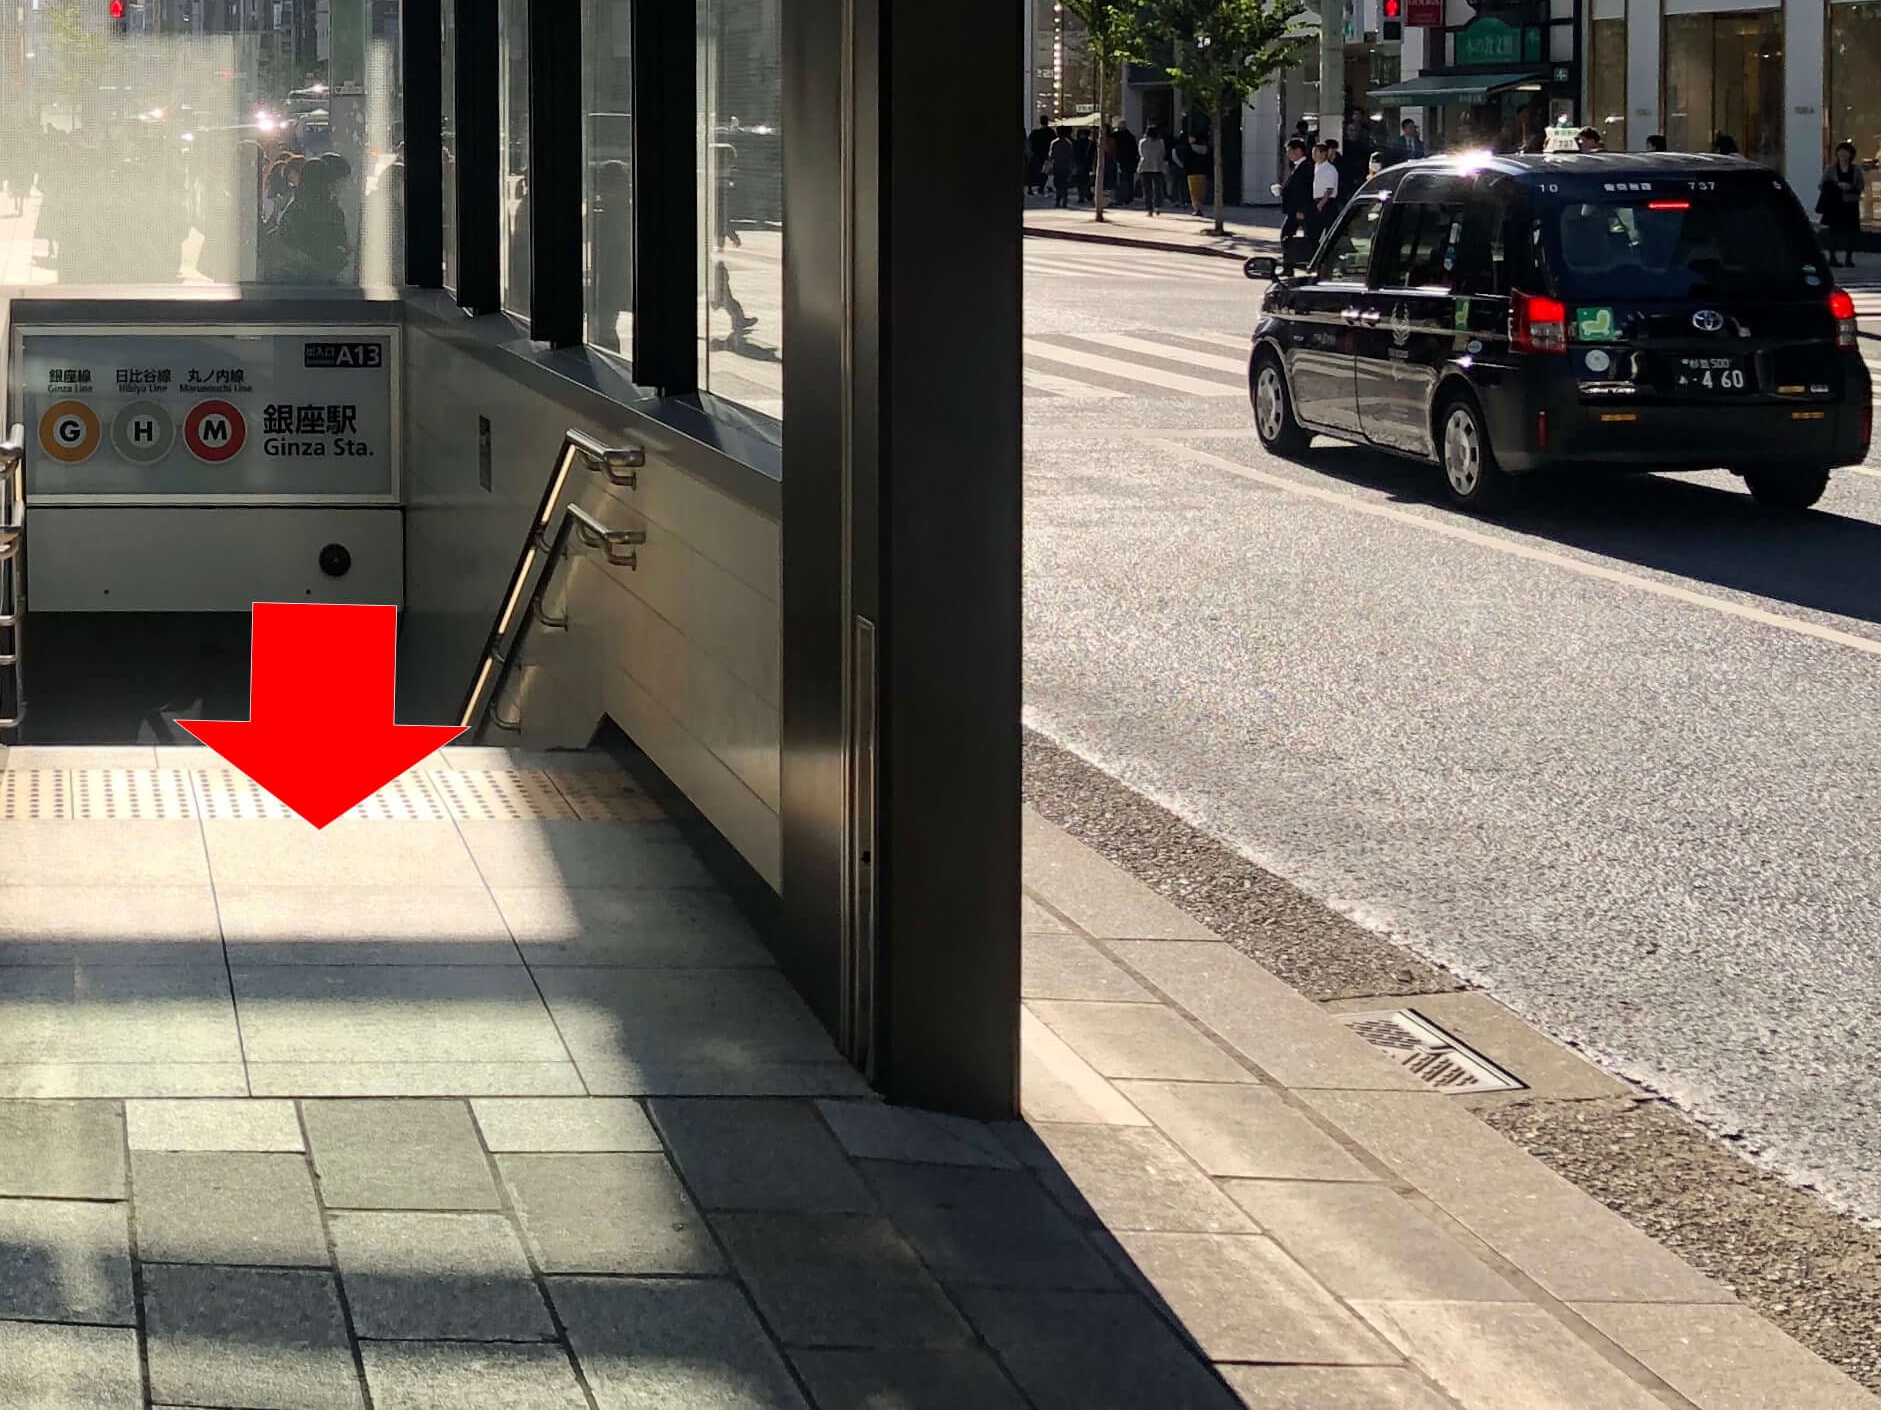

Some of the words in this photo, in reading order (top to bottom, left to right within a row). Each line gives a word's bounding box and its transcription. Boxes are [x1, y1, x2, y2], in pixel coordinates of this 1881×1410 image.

[336, 345, 380, 365] A13
[48, 369, 91, 383] 銀座線
[116, 369, 171, 383] 日比谷線
[188, 369, 244, 383] 丸ノ内線
[48, 384, 72, 393] Ginza
[263, 404, 358, 435] 銀座駅
[60, 420, 81, 442] G
[134, 421, 153, 442] H
[203, 420, 227, 441] M
[264, 437, 326, 456] Ginza
[333, 437, 375, 457] Sta.
